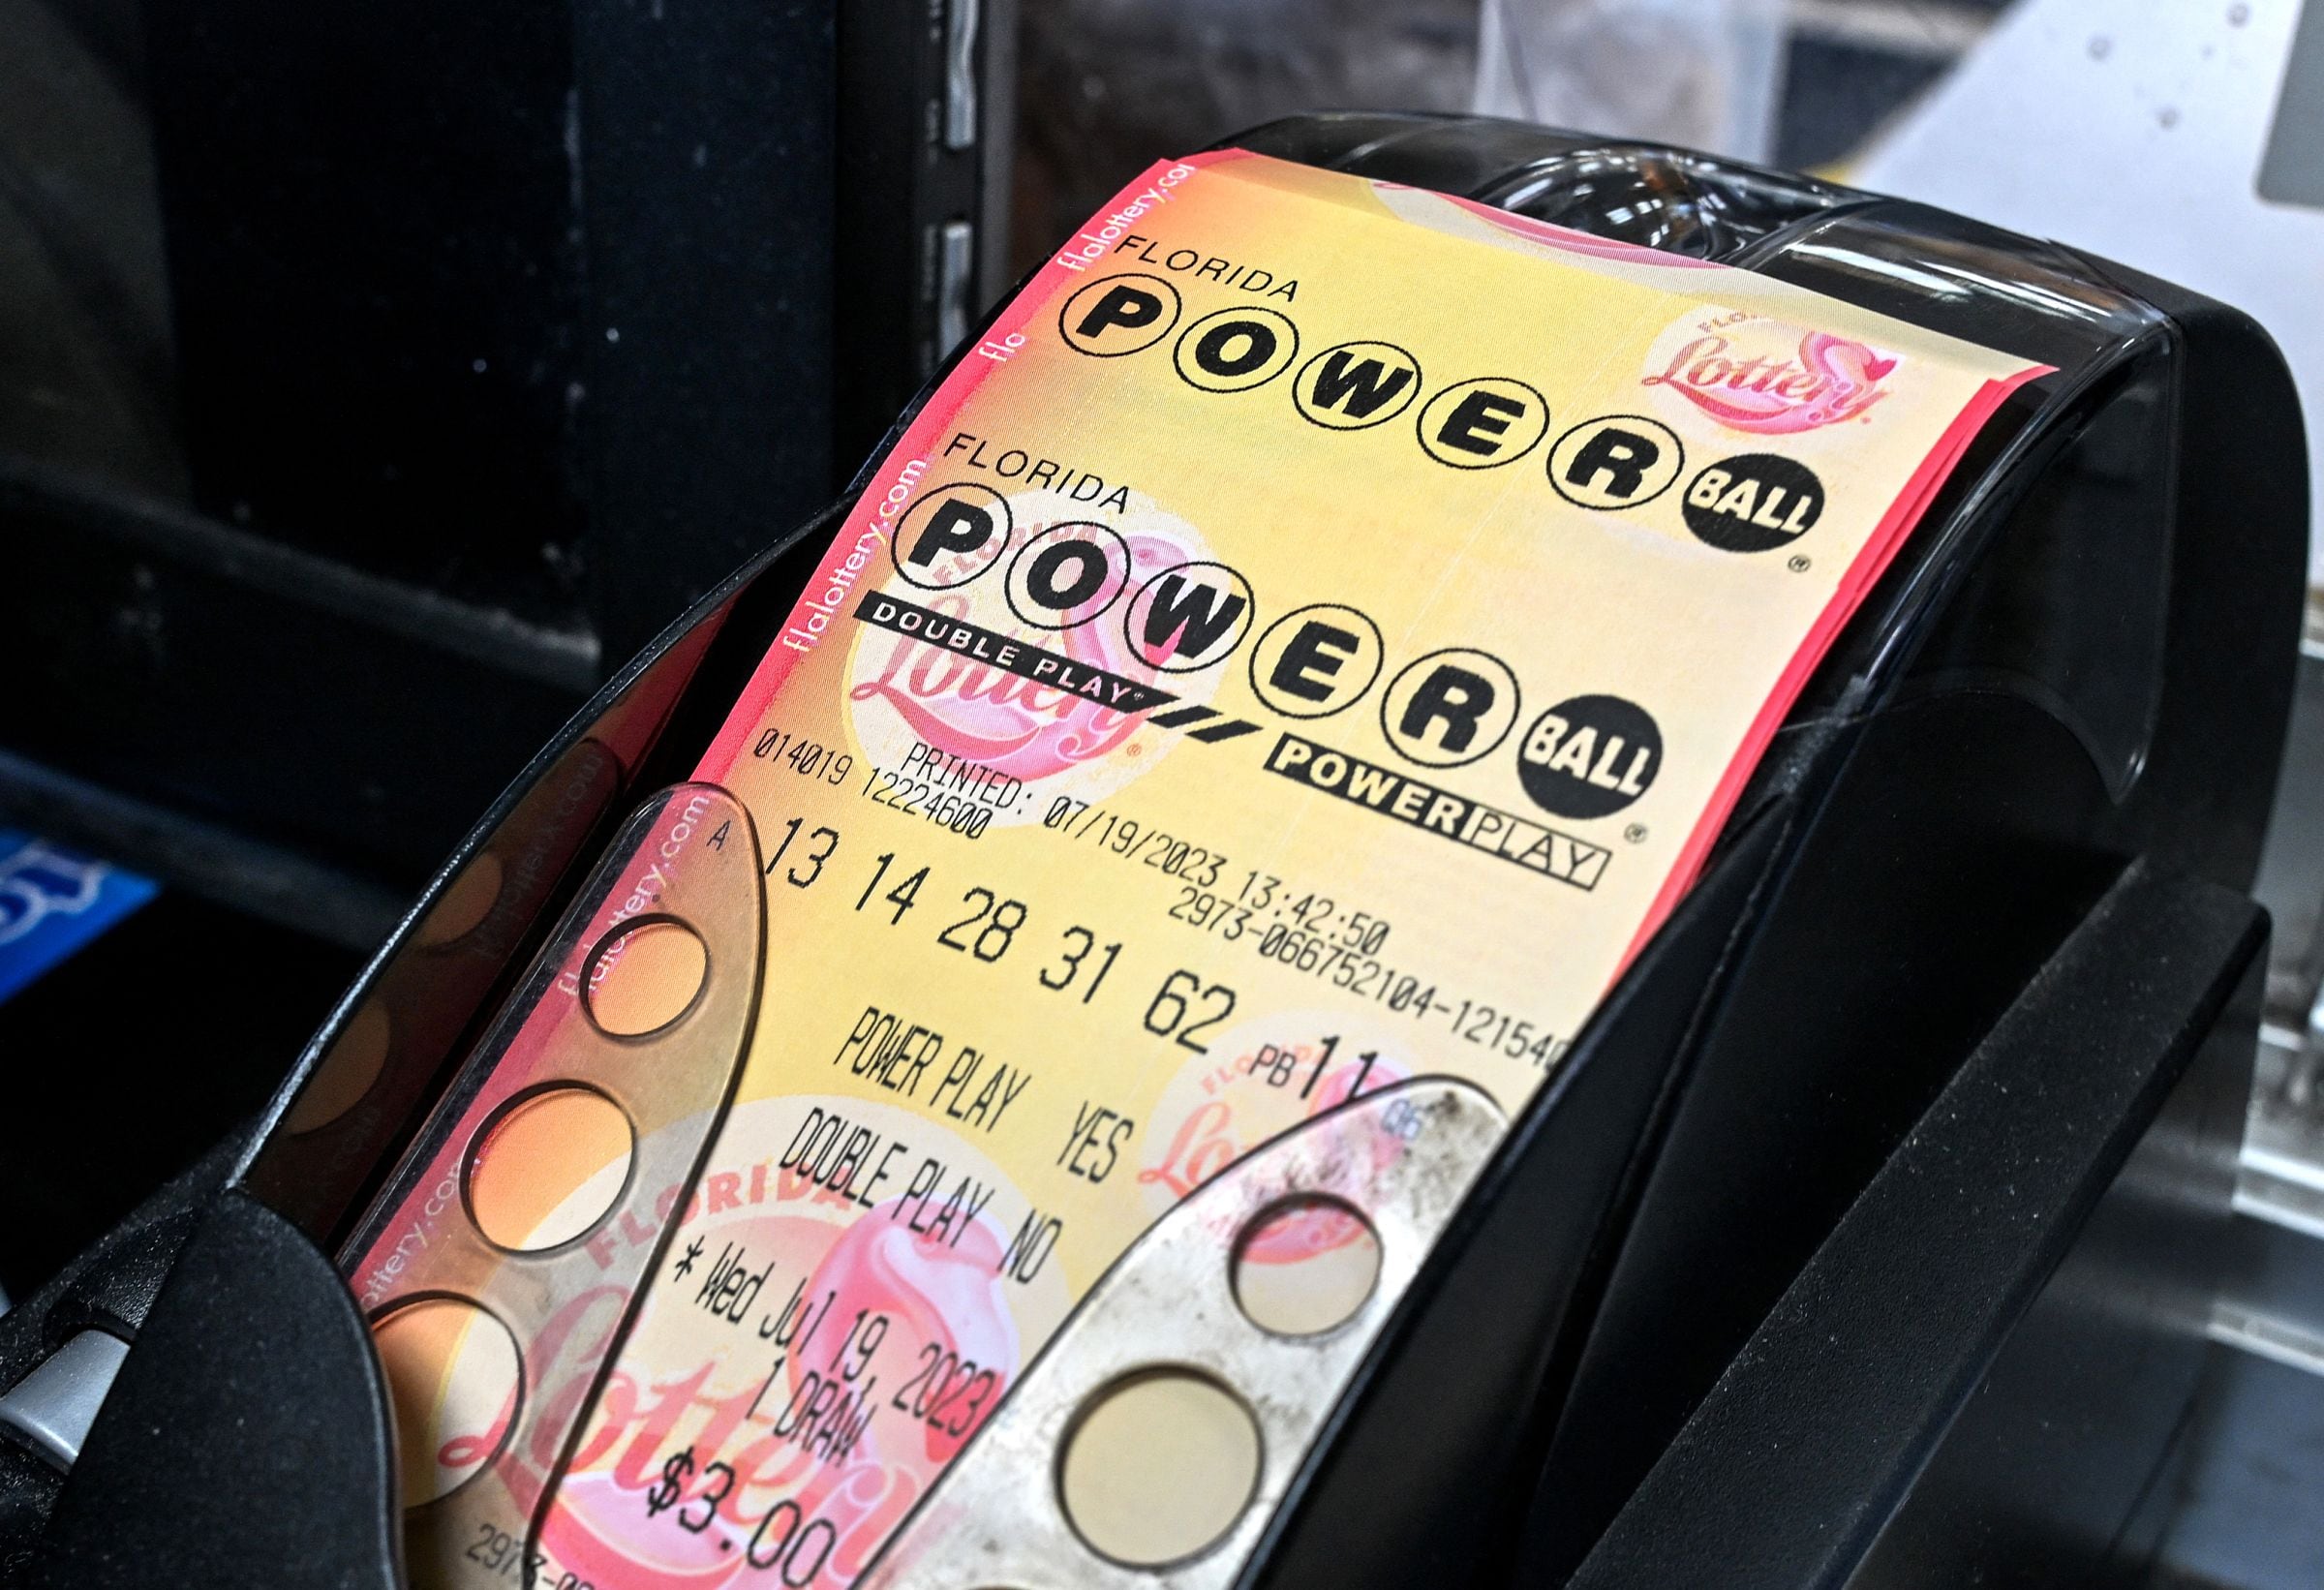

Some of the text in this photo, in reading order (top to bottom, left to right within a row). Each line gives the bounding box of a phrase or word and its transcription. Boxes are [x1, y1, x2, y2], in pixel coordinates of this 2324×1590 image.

[1057, 163, 1196, 272] flalottery.co
[1114, 234, 1300, 303] FLORIDA
[1640, 334, 1895, 428] Lottery
[942, 432, 1131, 515] FLORIDA
[782, 457, 928, 653] flalottery.com
[872, 601, 1135, 705] DOUBLE PLAY
[753, 727, 1391, 957] 014019 PRINTED: 07/19/2023 13:42:50
[861, 766, 994, 840] 12224600
[706, 819, 732, 851] A
[764, 816, 840, 889] 13
[854, 852, 932, 926] 14
[936, 885, 1027, 963] 28
[1039, 925, 1123, 1004] 31
[1143, 968, 1237, 1055] 62
[833, 1006, 944, 1097] POWER
[929, 1046, 1032, 1133] PLAY
[1055, 1099, 1135, 1184] YES
[583, 1163, 852, 1271] FLORIDA
[779, 1106, 1063, 1285] DOUBLE PLAY NO
[694, 1240, 776, 1325] Wed
[758, 1276, 837, 1357] Jul
[891, 1341, 996, 1438] 2023
[744, 1356, 878, 1468] 1 DRAW
[647, 1446, 837, 1589] $3.00
